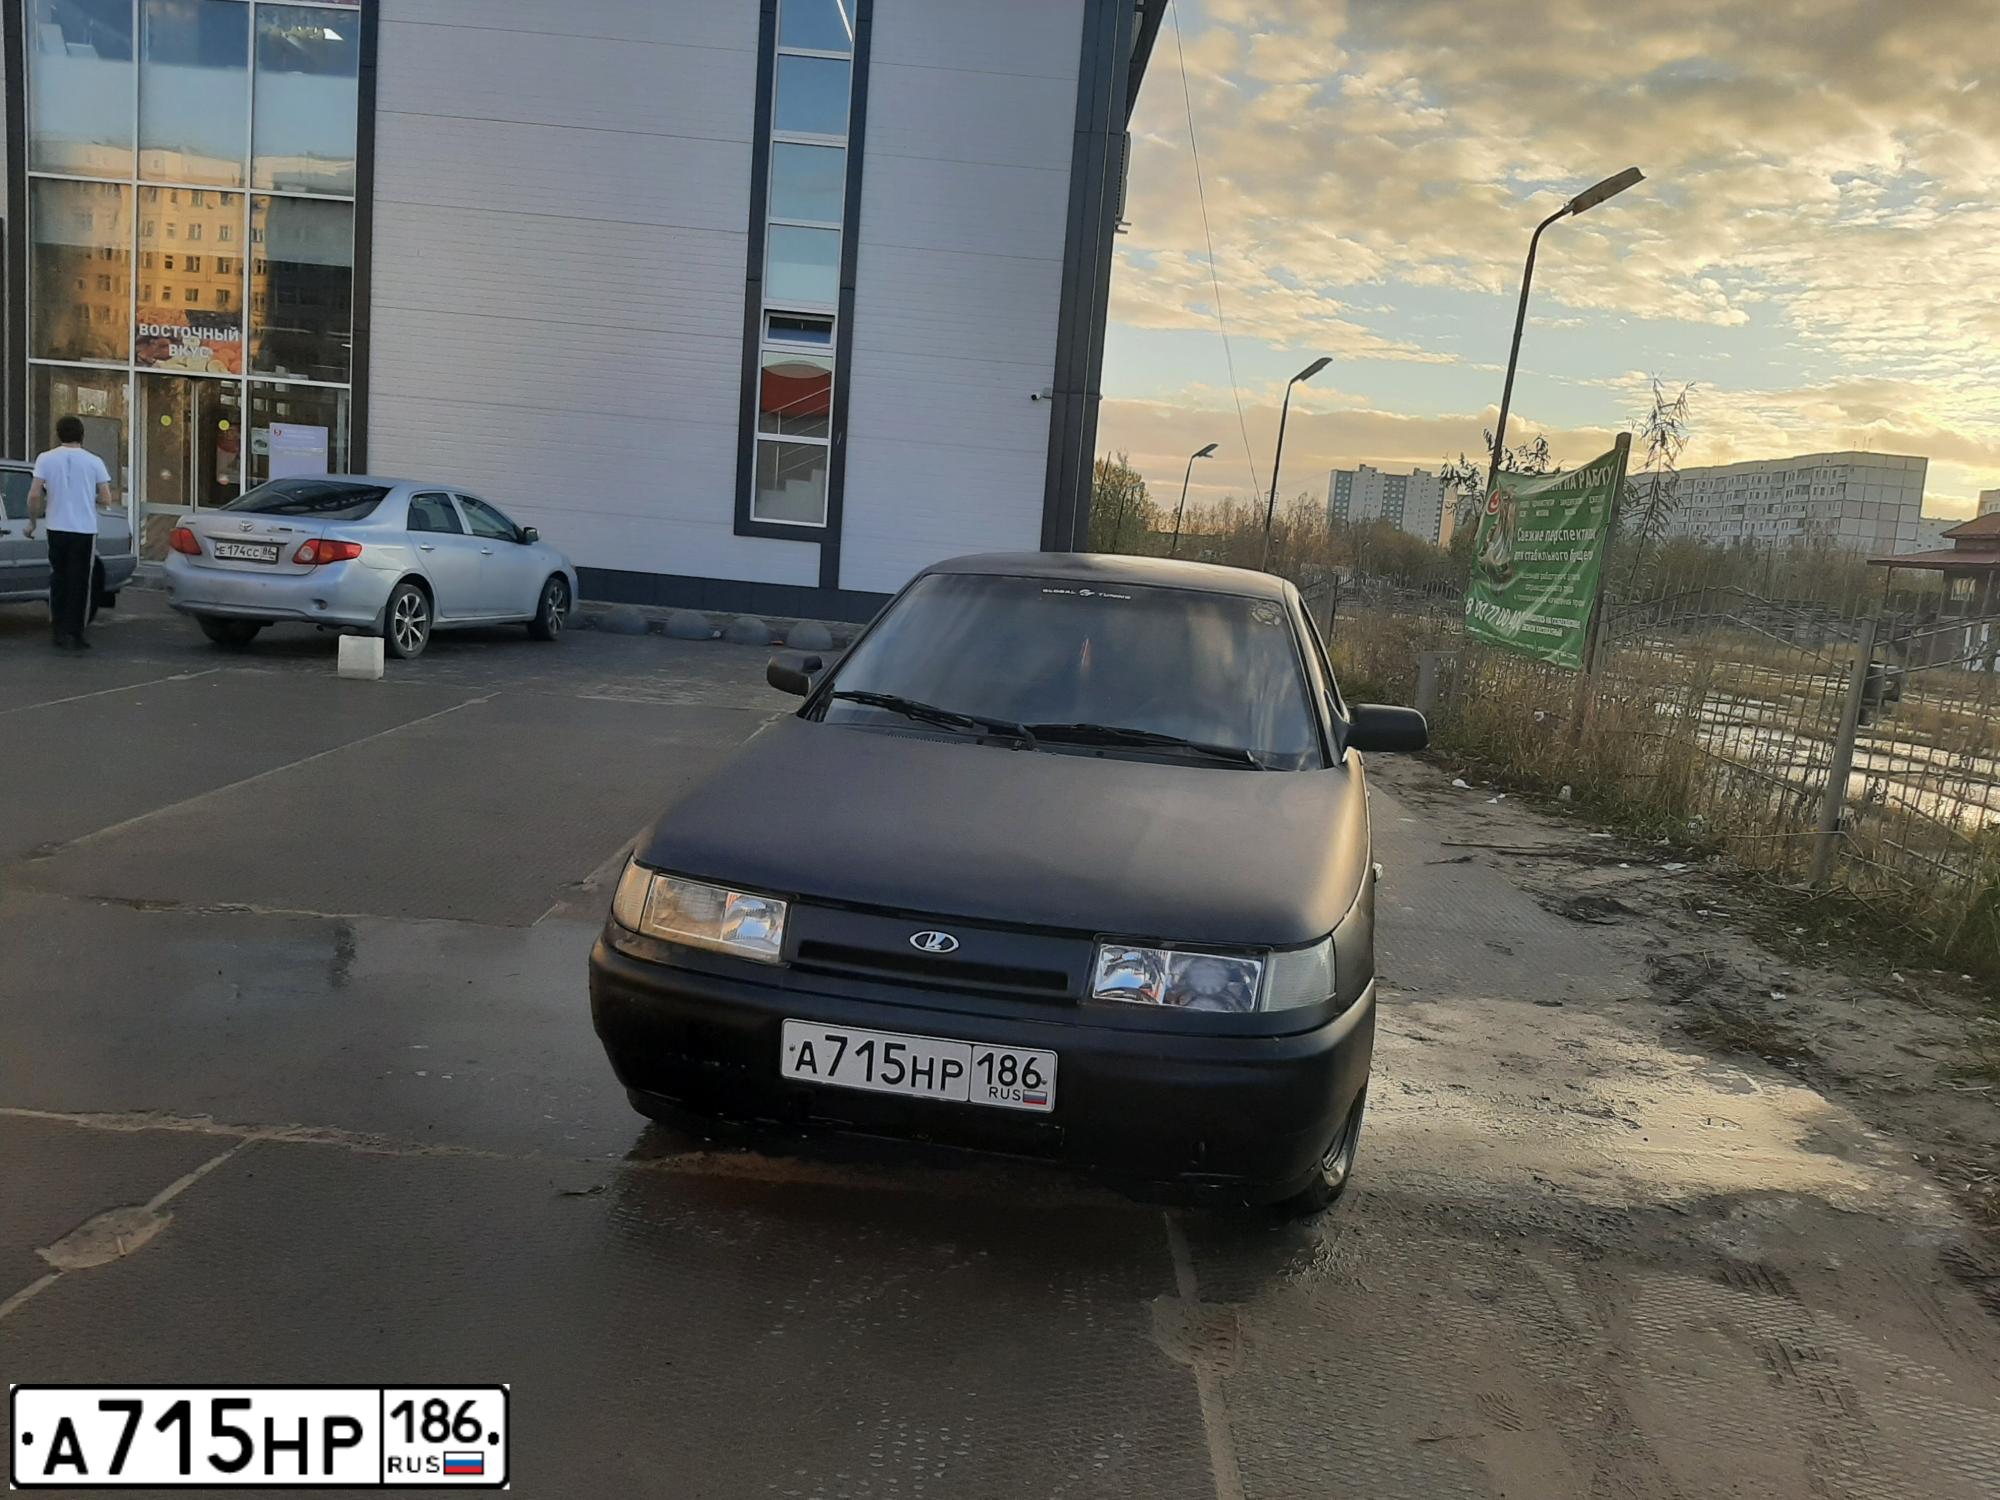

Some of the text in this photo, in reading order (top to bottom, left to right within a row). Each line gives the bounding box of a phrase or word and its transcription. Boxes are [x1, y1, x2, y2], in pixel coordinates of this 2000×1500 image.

[140, 323, 239, 342] ВОСТОЧНЫЙ
[168, 344, 212, 358] ВКУС
[1517, 528, 1544, 542] Свежие
[795, 1034, 1042, 1091] А715НР 186
[988, 1086, 1021, 1101] RUS
